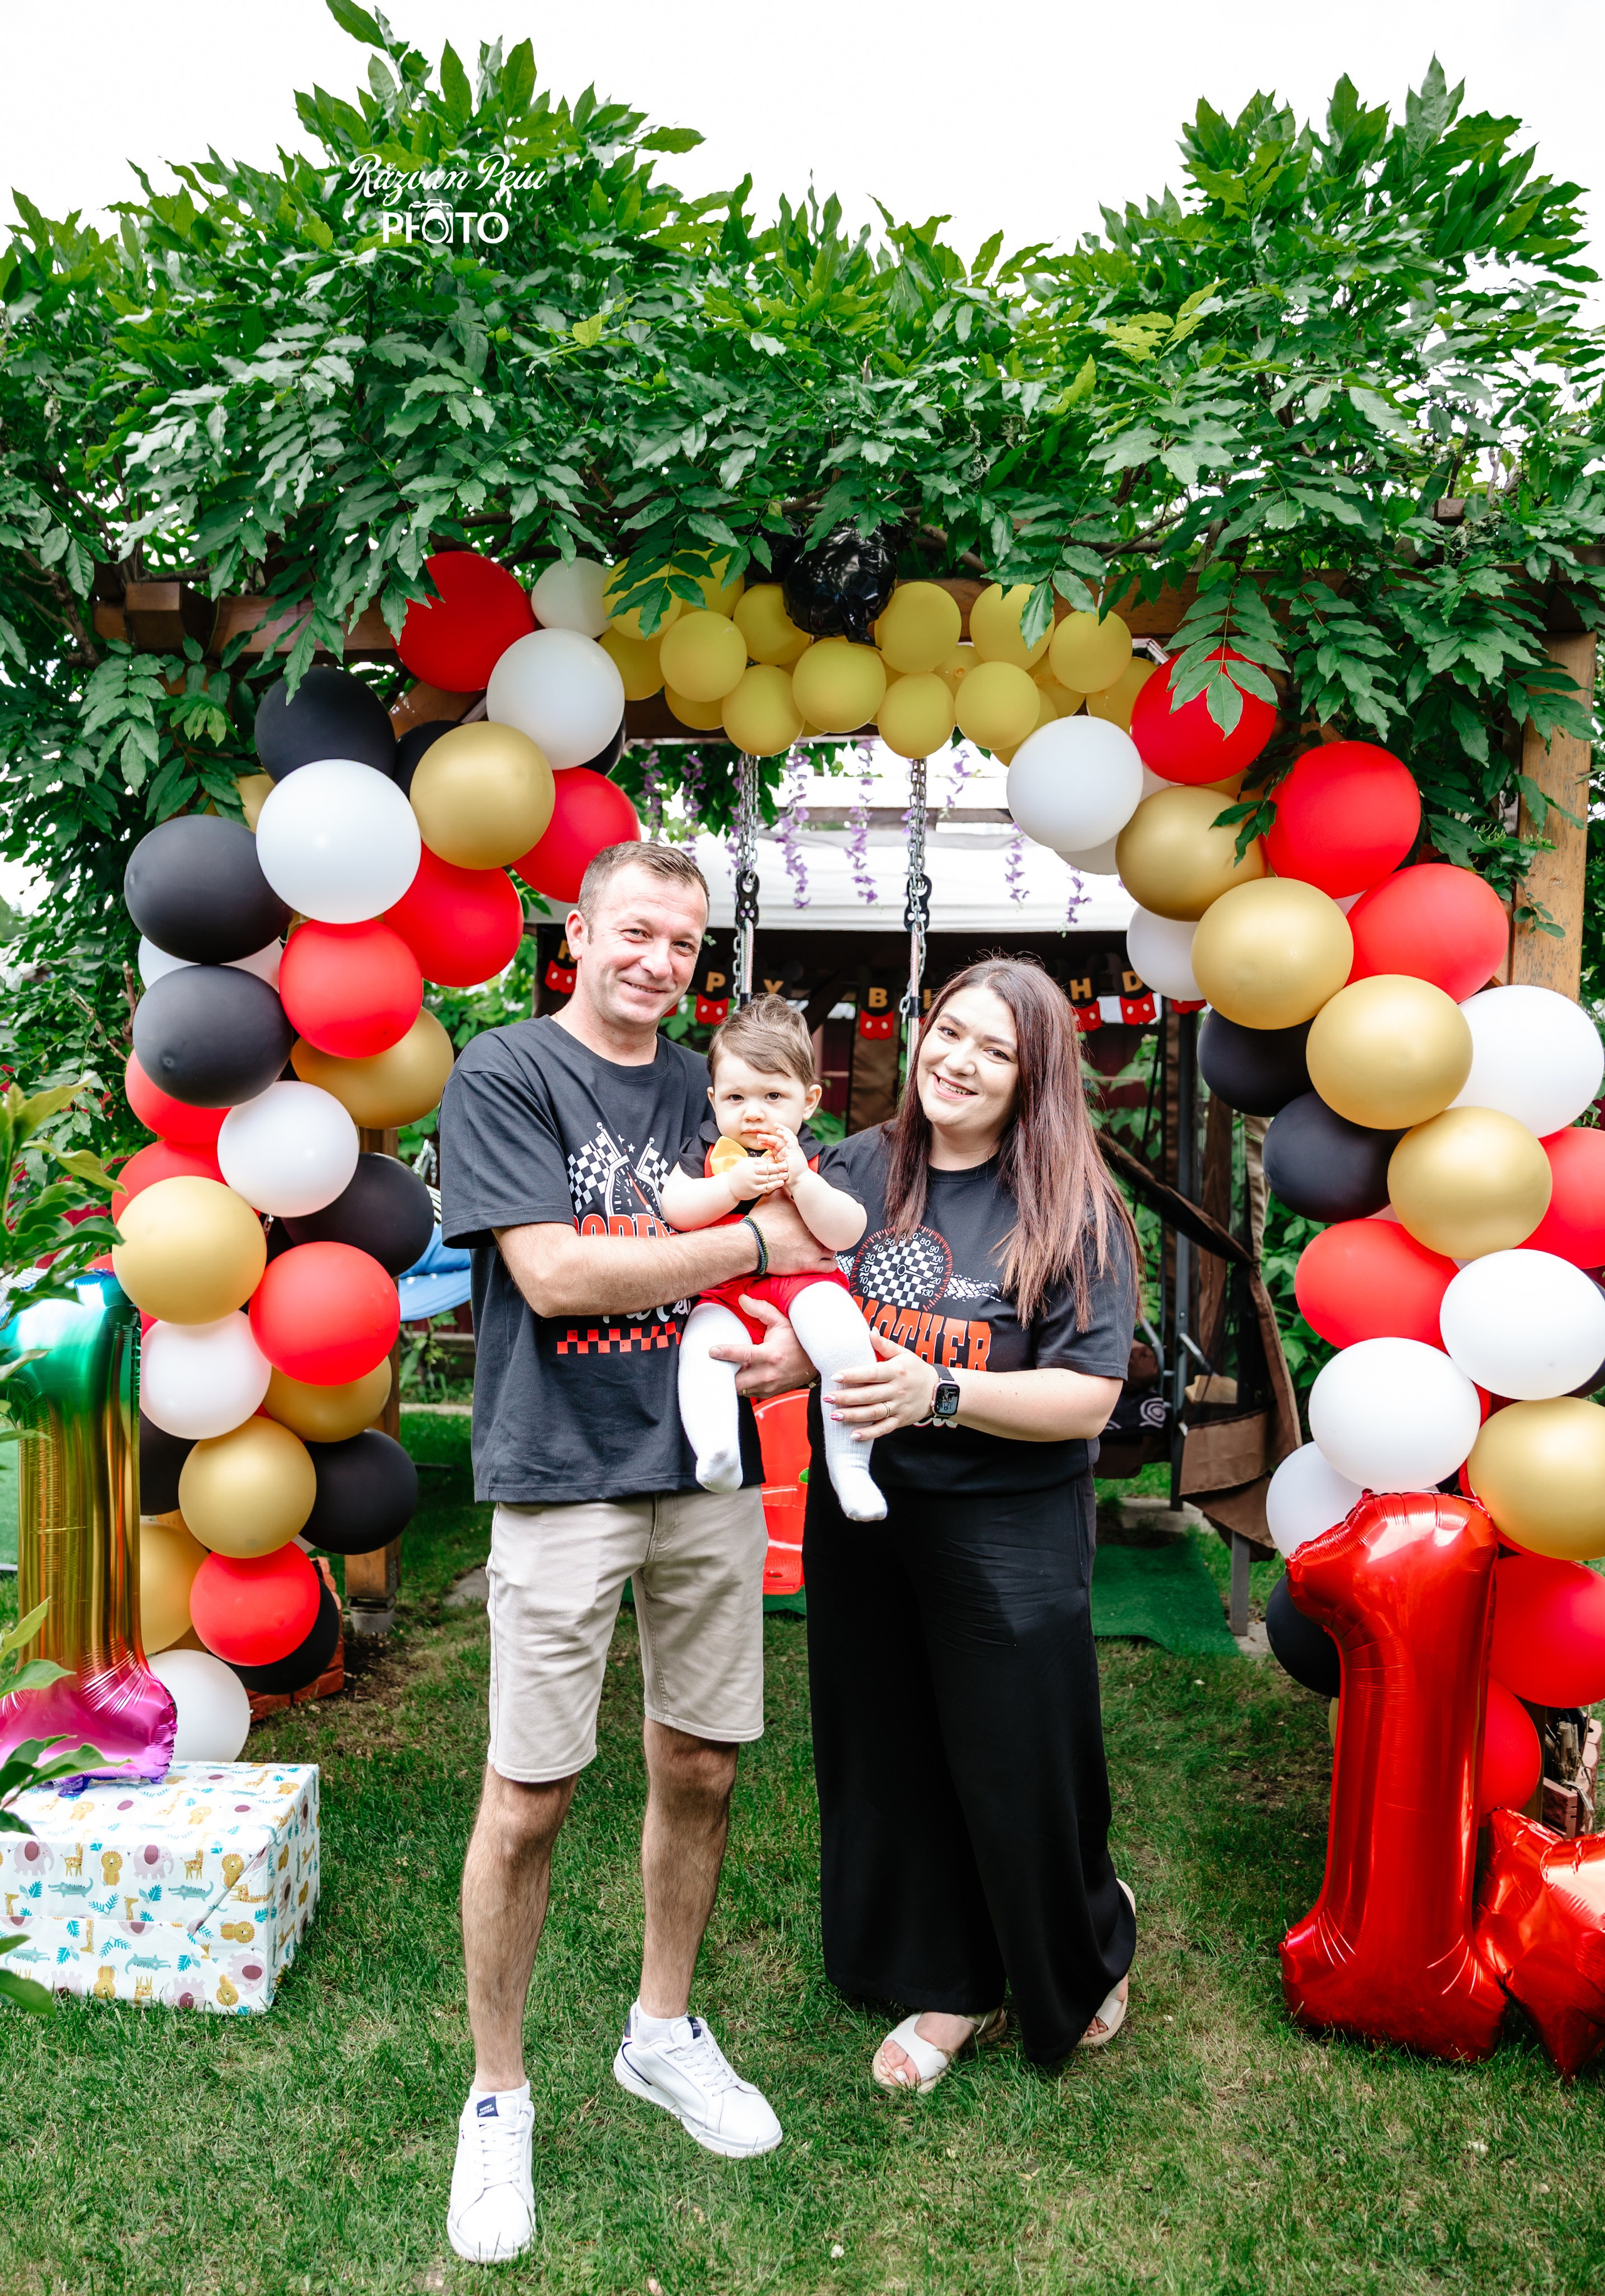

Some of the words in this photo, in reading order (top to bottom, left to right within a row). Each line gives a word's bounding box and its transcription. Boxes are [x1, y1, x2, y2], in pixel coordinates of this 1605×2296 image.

[885, 1238, 895, 1246] 50
[919, 1238, 931, 1247] 80
[873, 1244, 884, 1252] 40
[929, 1245, 940, 1254] 90
[865, 1252, 876, 1261] 30
[932, 1255, 944, 1263] 100
[859, 1264, 870, 1272] 20
[933, 1266, 944, 1274] 110
[860, 1276, 868, 1284] 10
[862, 1286, 868, 1294] 0
[922, 1289, 934, 1297] 130
